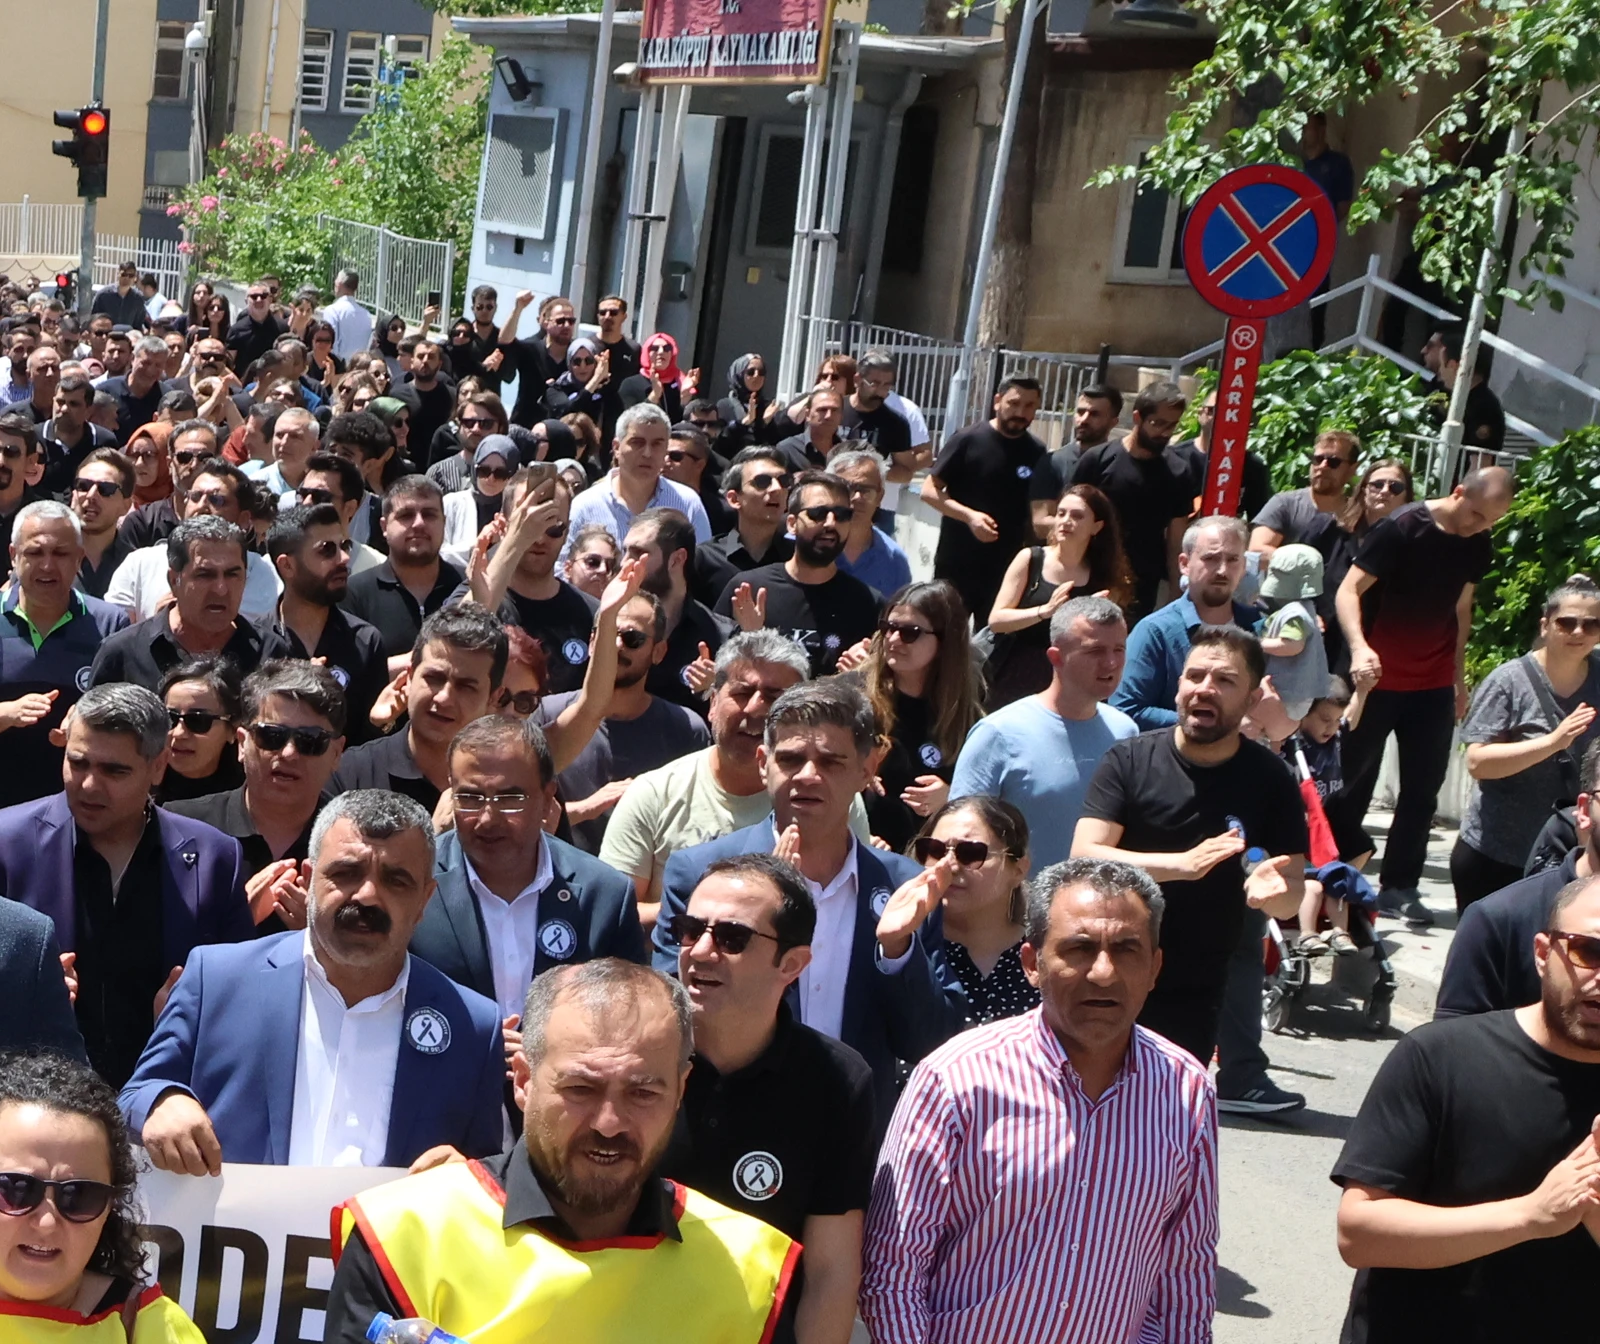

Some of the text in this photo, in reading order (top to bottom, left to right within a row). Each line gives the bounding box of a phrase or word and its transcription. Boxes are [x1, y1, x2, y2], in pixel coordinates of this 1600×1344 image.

[638, 21, 818, 68] KARAKÖPRÜ KAYMAKAMLIĞI
[1224, 356, 1247, 422] PARK
